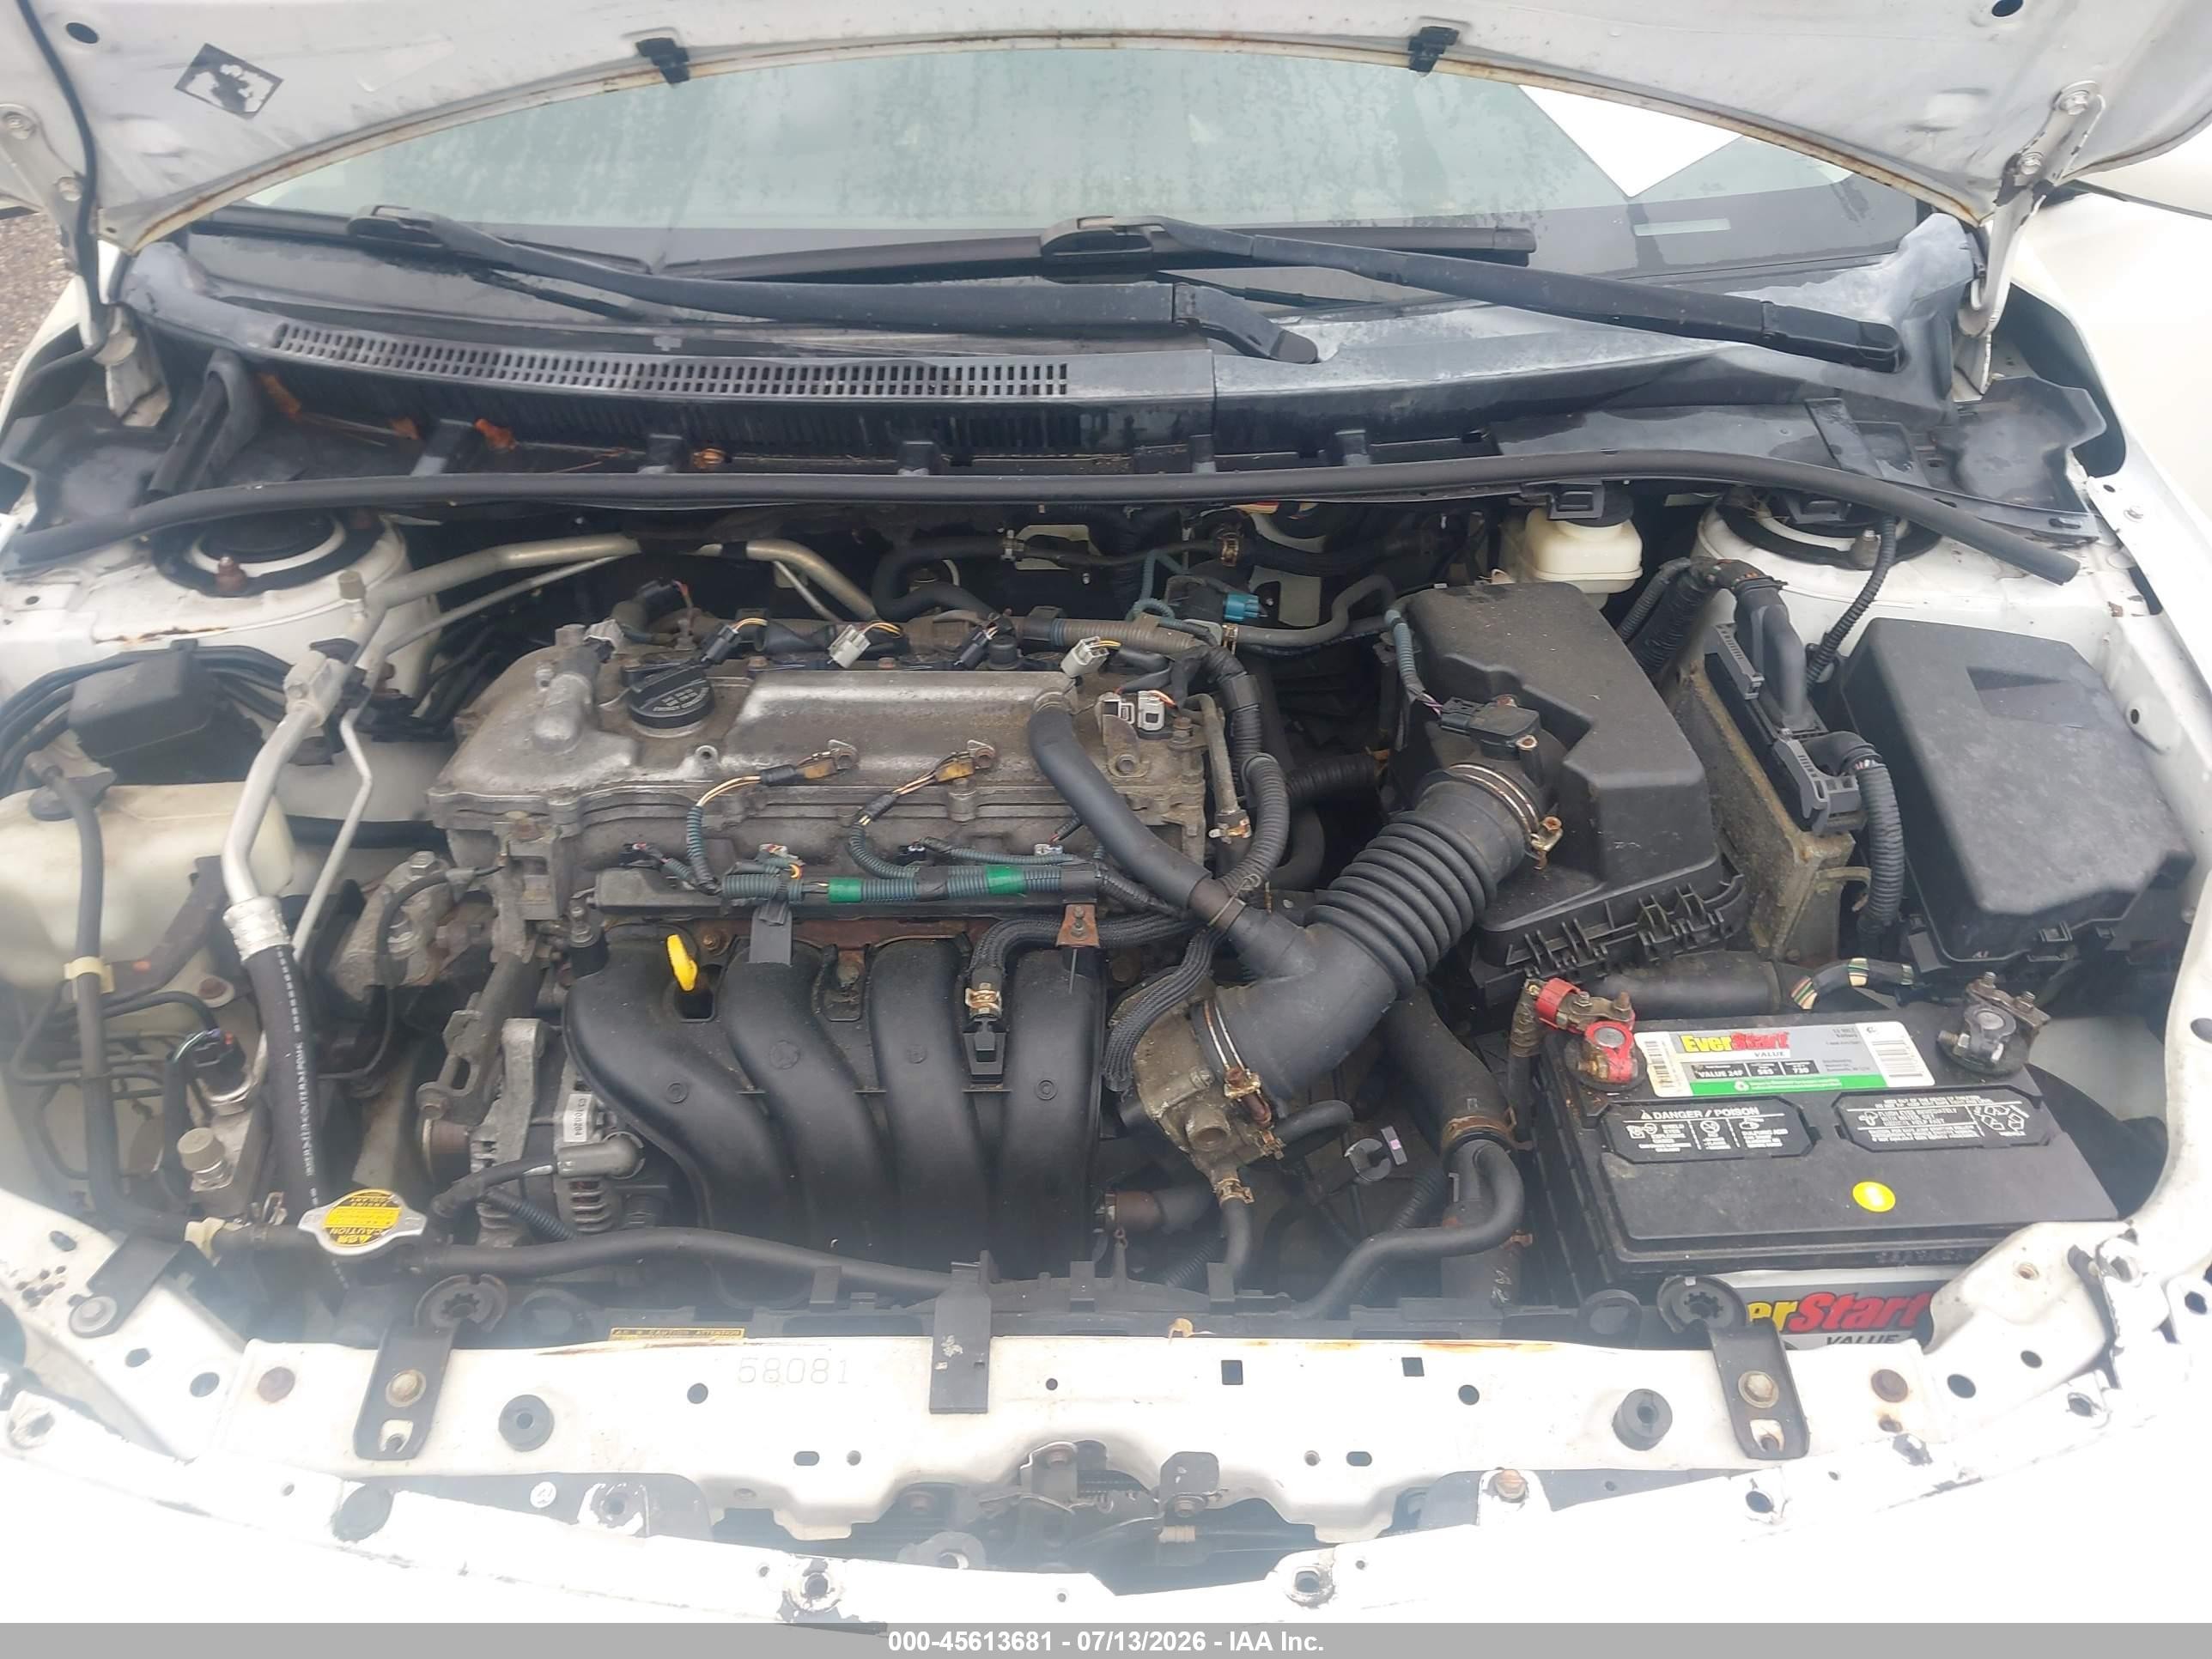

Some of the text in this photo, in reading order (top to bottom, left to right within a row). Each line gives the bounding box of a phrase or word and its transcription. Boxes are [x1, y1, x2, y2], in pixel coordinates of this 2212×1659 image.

[1680, 1031, 1790, 1053] EverStart
[1653, 1110, 1704, 1120] DANGER
[1714, 1107, 1760, 1116] POISON
[1747, 1291, 1935, 1332] erStart
